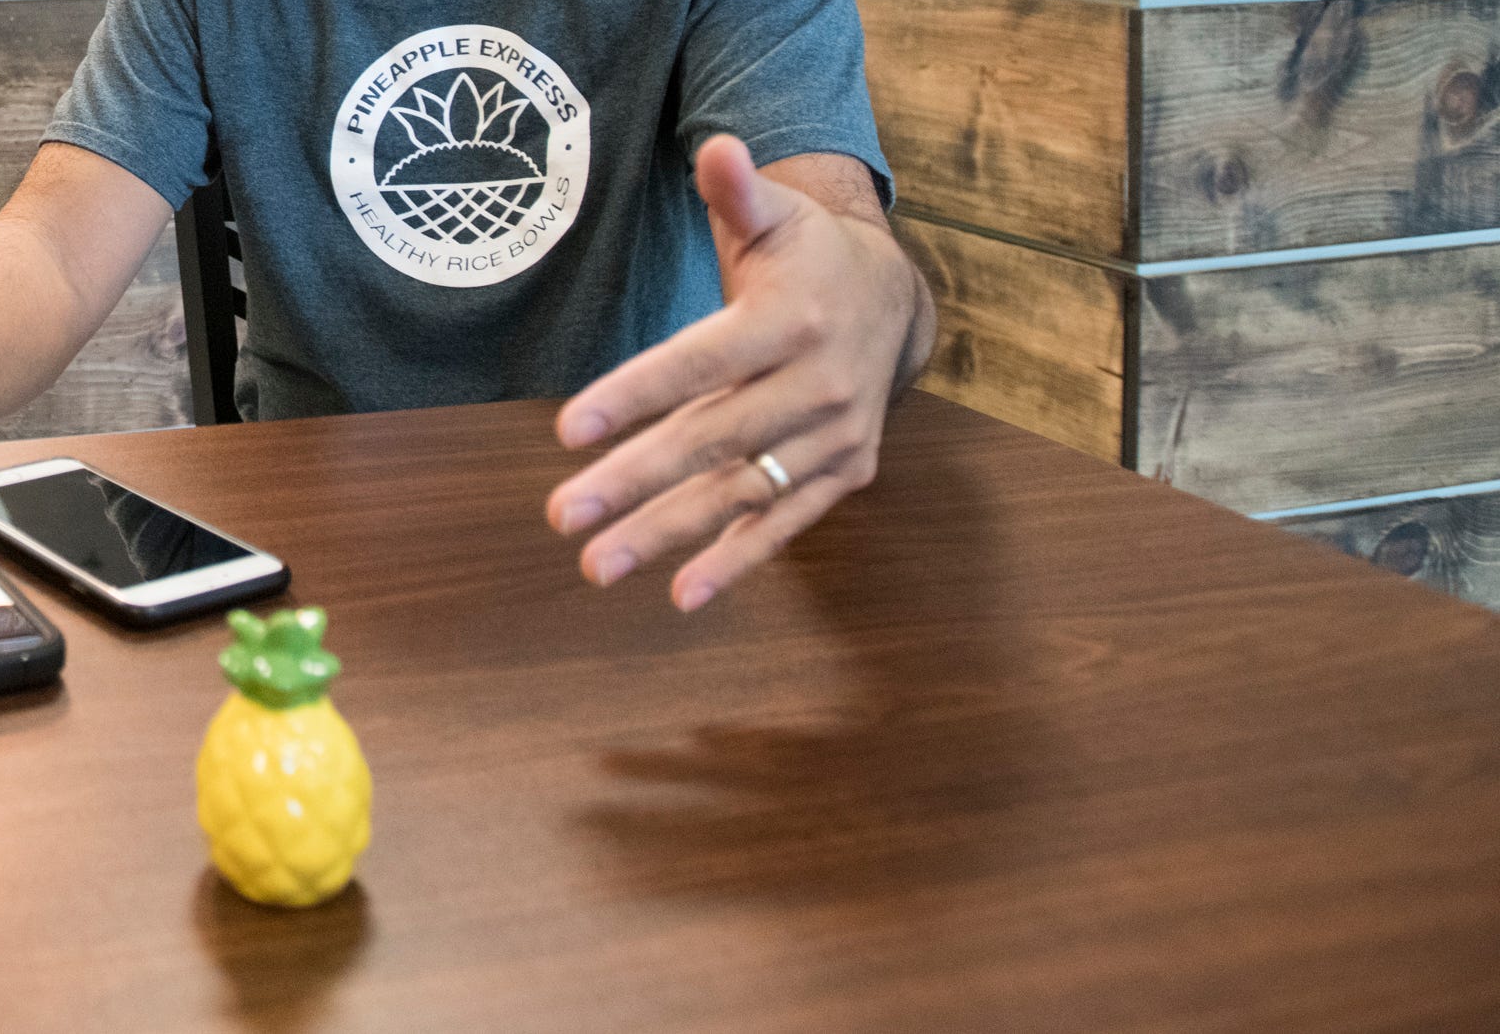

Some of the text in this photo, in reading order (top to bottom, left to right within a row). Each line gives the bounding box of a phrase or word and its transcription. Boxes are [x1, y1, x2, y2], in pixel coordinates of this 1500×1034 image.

[347, 38, 578, 135] PINEAPPLE EXPRESS
[349, 176, 570, 272] HEALTHY RICE BOWLS
